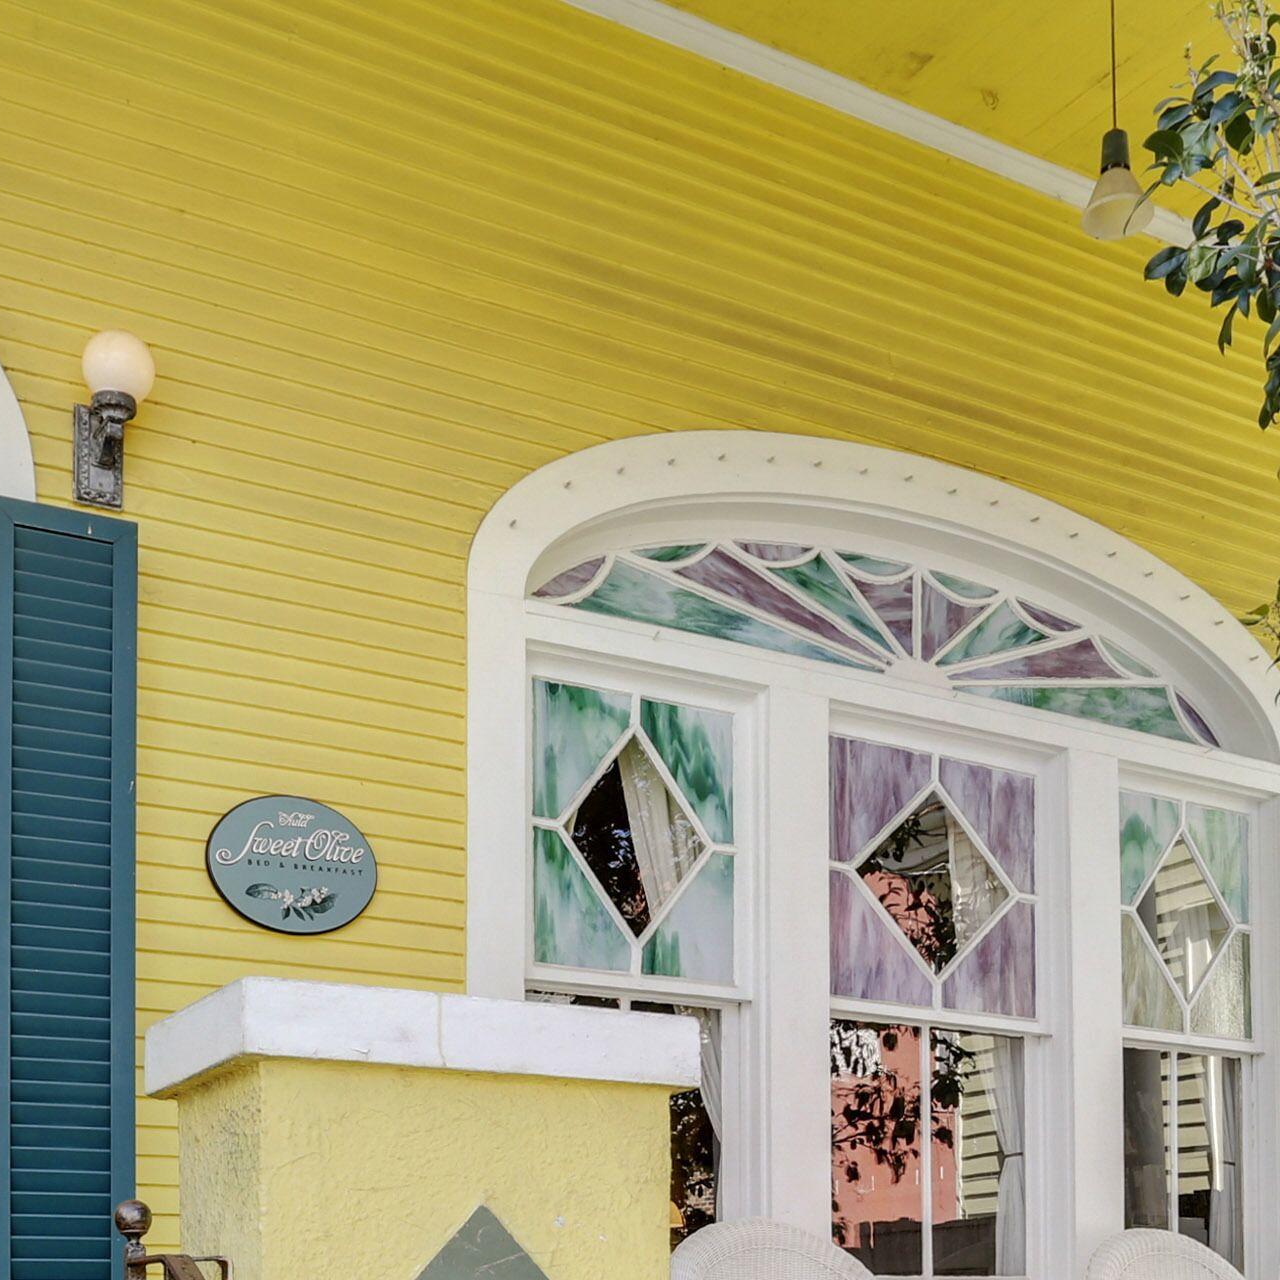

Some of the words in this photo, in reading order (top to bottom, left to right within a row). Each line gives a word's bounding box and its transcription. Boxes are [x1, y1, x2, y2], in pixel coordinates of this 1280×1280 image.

[216, 821, 306, 865] Sweet
[305, 829, 364, 864] Olive
[247, 858, 271, 867] BED
[293, 863, 363, 876] BREAKFAST
